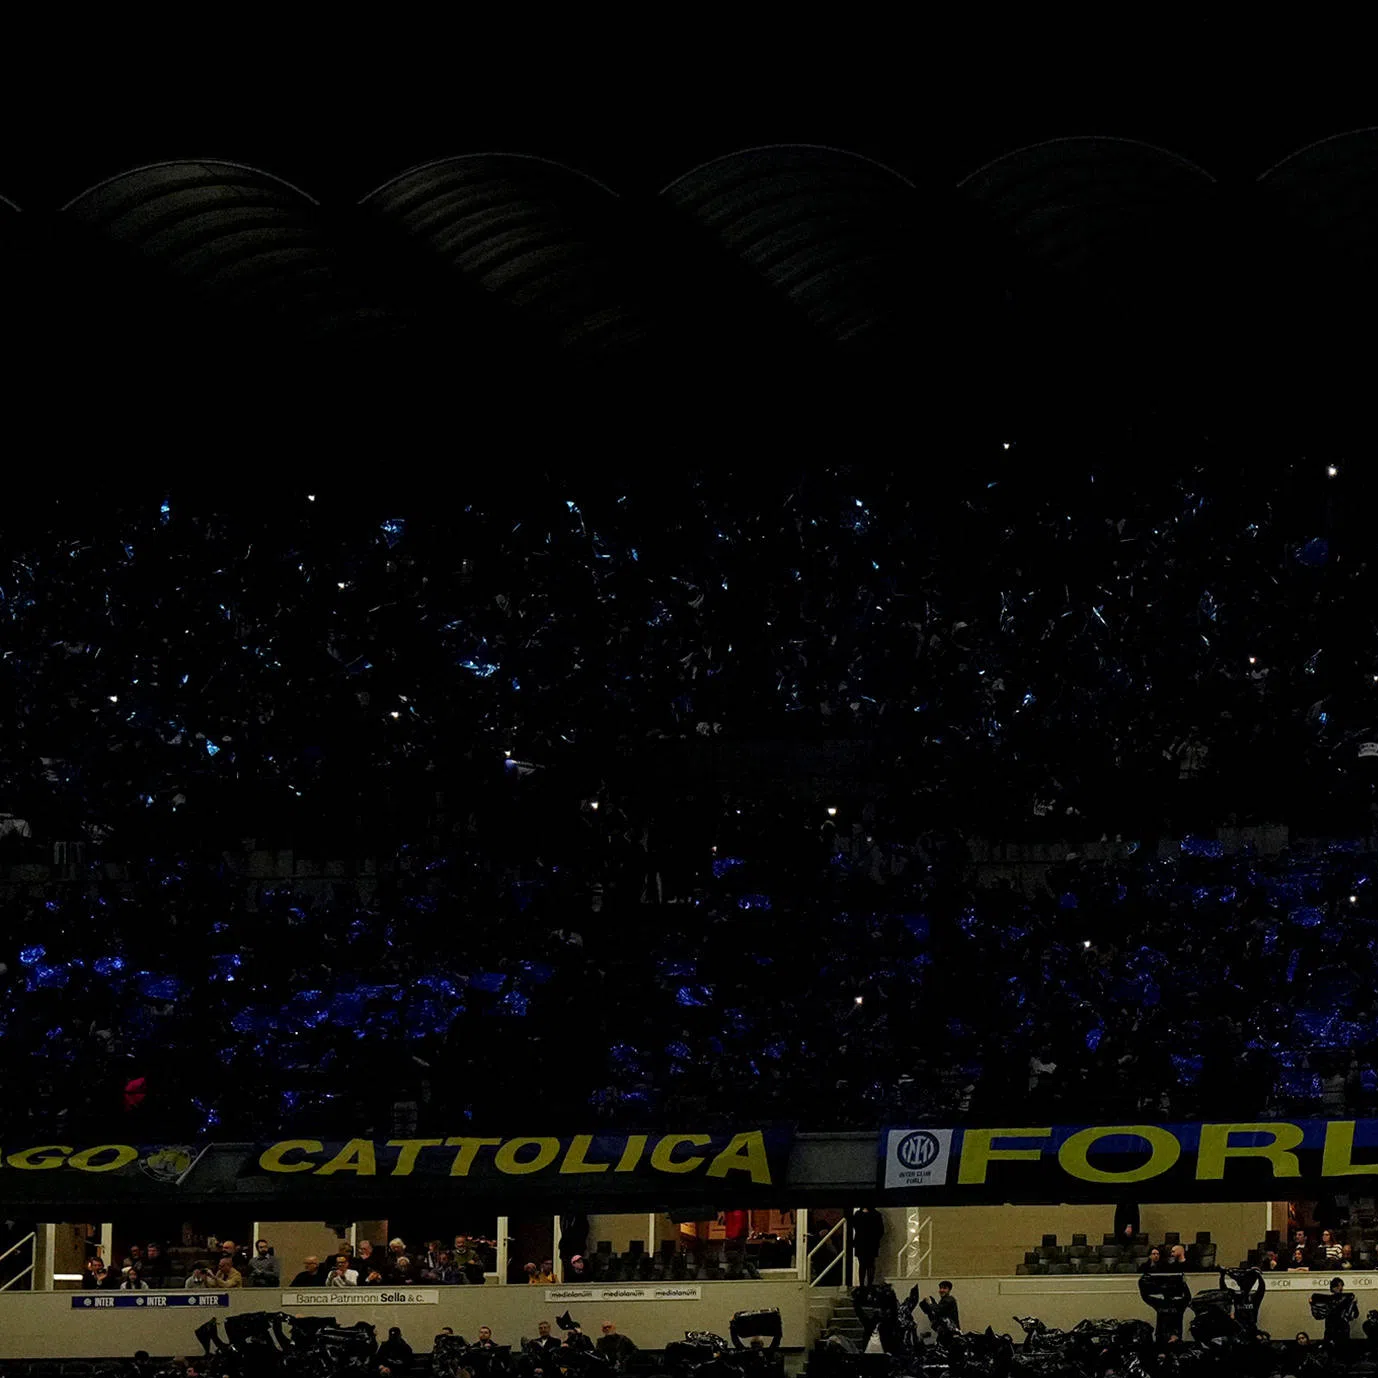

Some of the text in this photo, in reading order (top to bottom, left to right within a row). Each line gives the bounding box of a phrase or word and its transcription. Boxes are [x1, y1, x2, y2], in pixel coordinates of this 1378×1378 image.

[0, 1144, 139, 1172] GO
[259, 1128, 773, 1185] CATTOLICA
[94, 1296, 115, 1307] INTER
[146, 1295, 167, 1307] INTER
[198, 1294, 219, 1306] INTER
[296, 1294, 329, 1304] Banca
[380, 1292, 406, 1303] Sella
